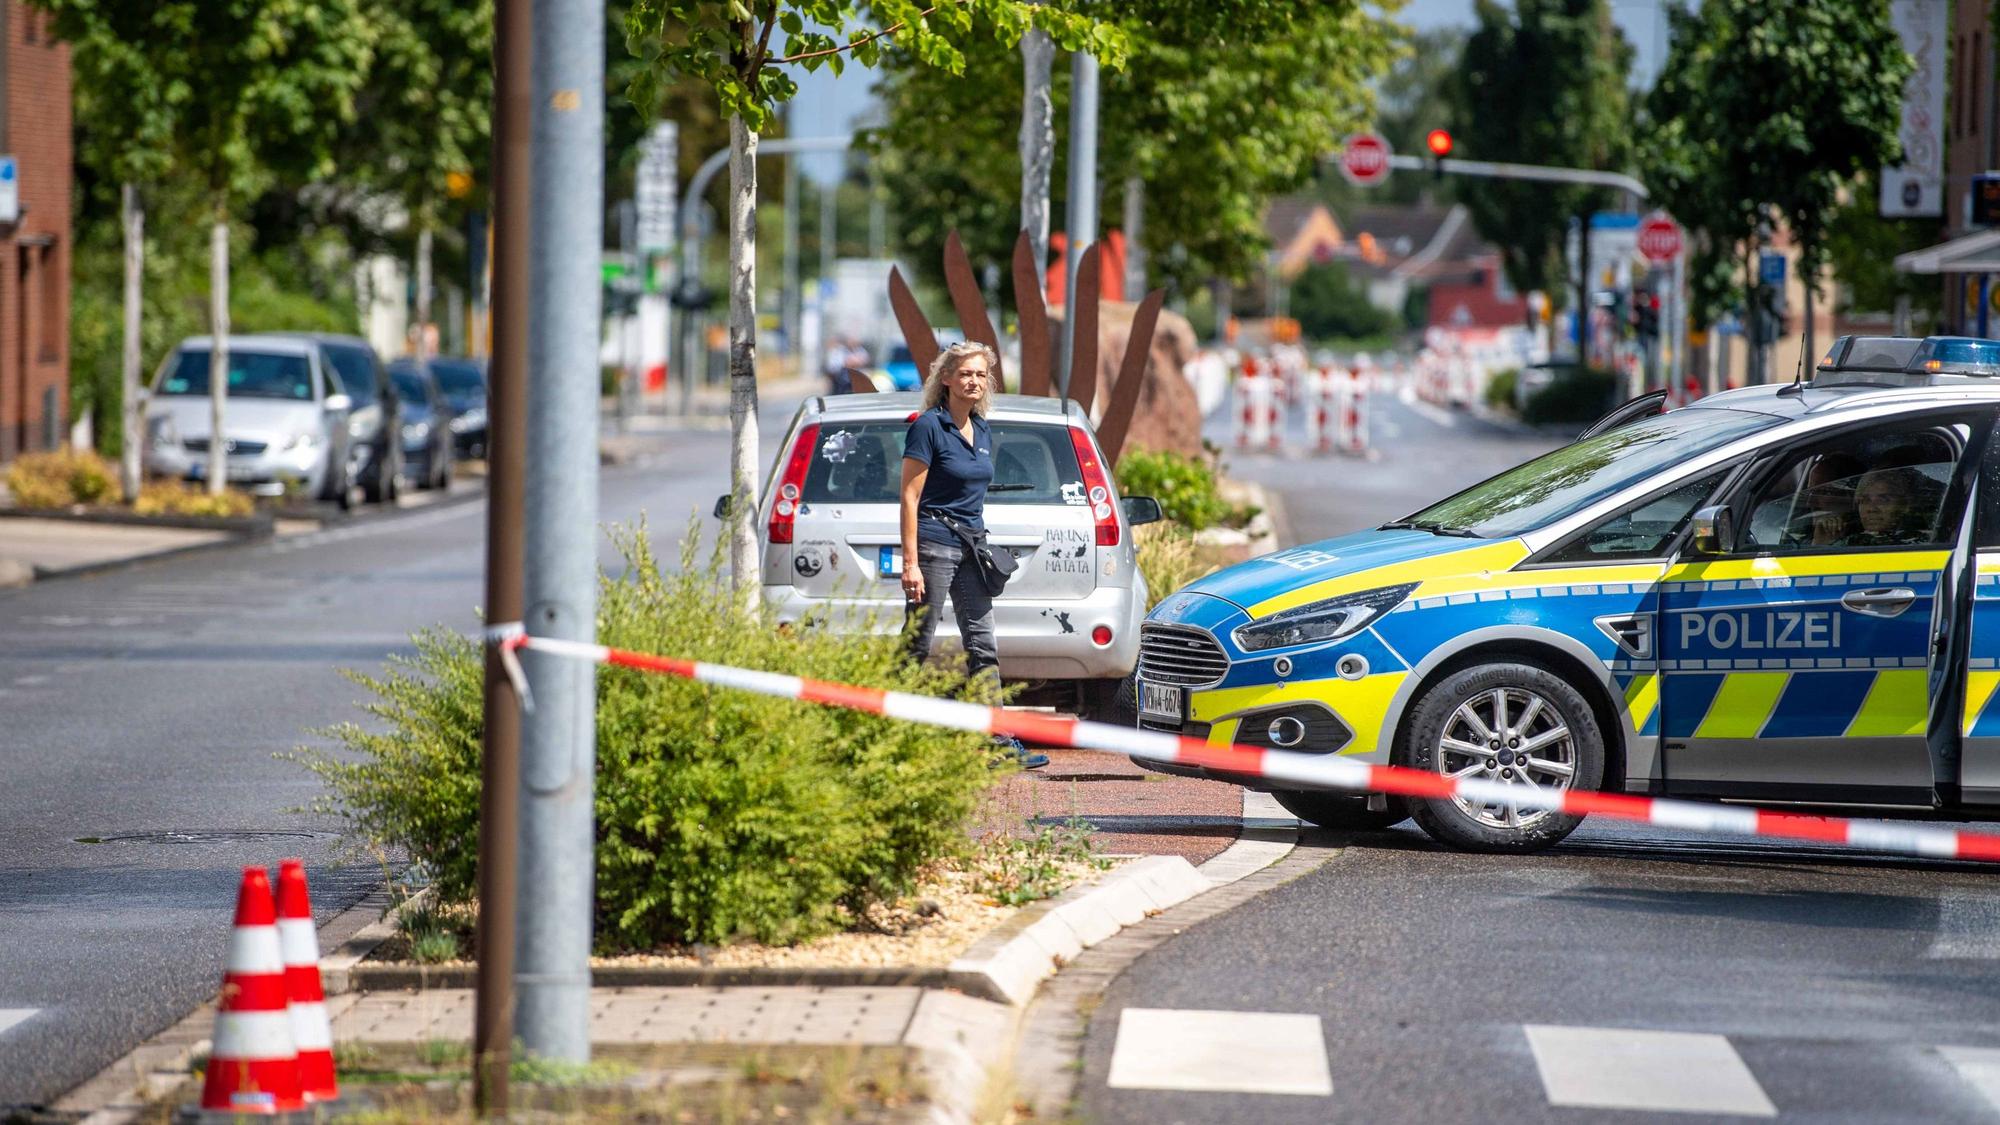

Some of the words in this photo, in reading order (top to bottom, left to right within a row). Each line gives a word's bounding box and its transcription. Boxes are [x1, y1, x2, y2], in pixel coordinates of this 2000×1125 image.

[1046, 529, 1089, 544] HAKUNA
[1045, 560, 1089, 574] MATATA
[1680, 611, 1841, 649] POLIZEI
[1454, 667, 1520, 695] Continental
